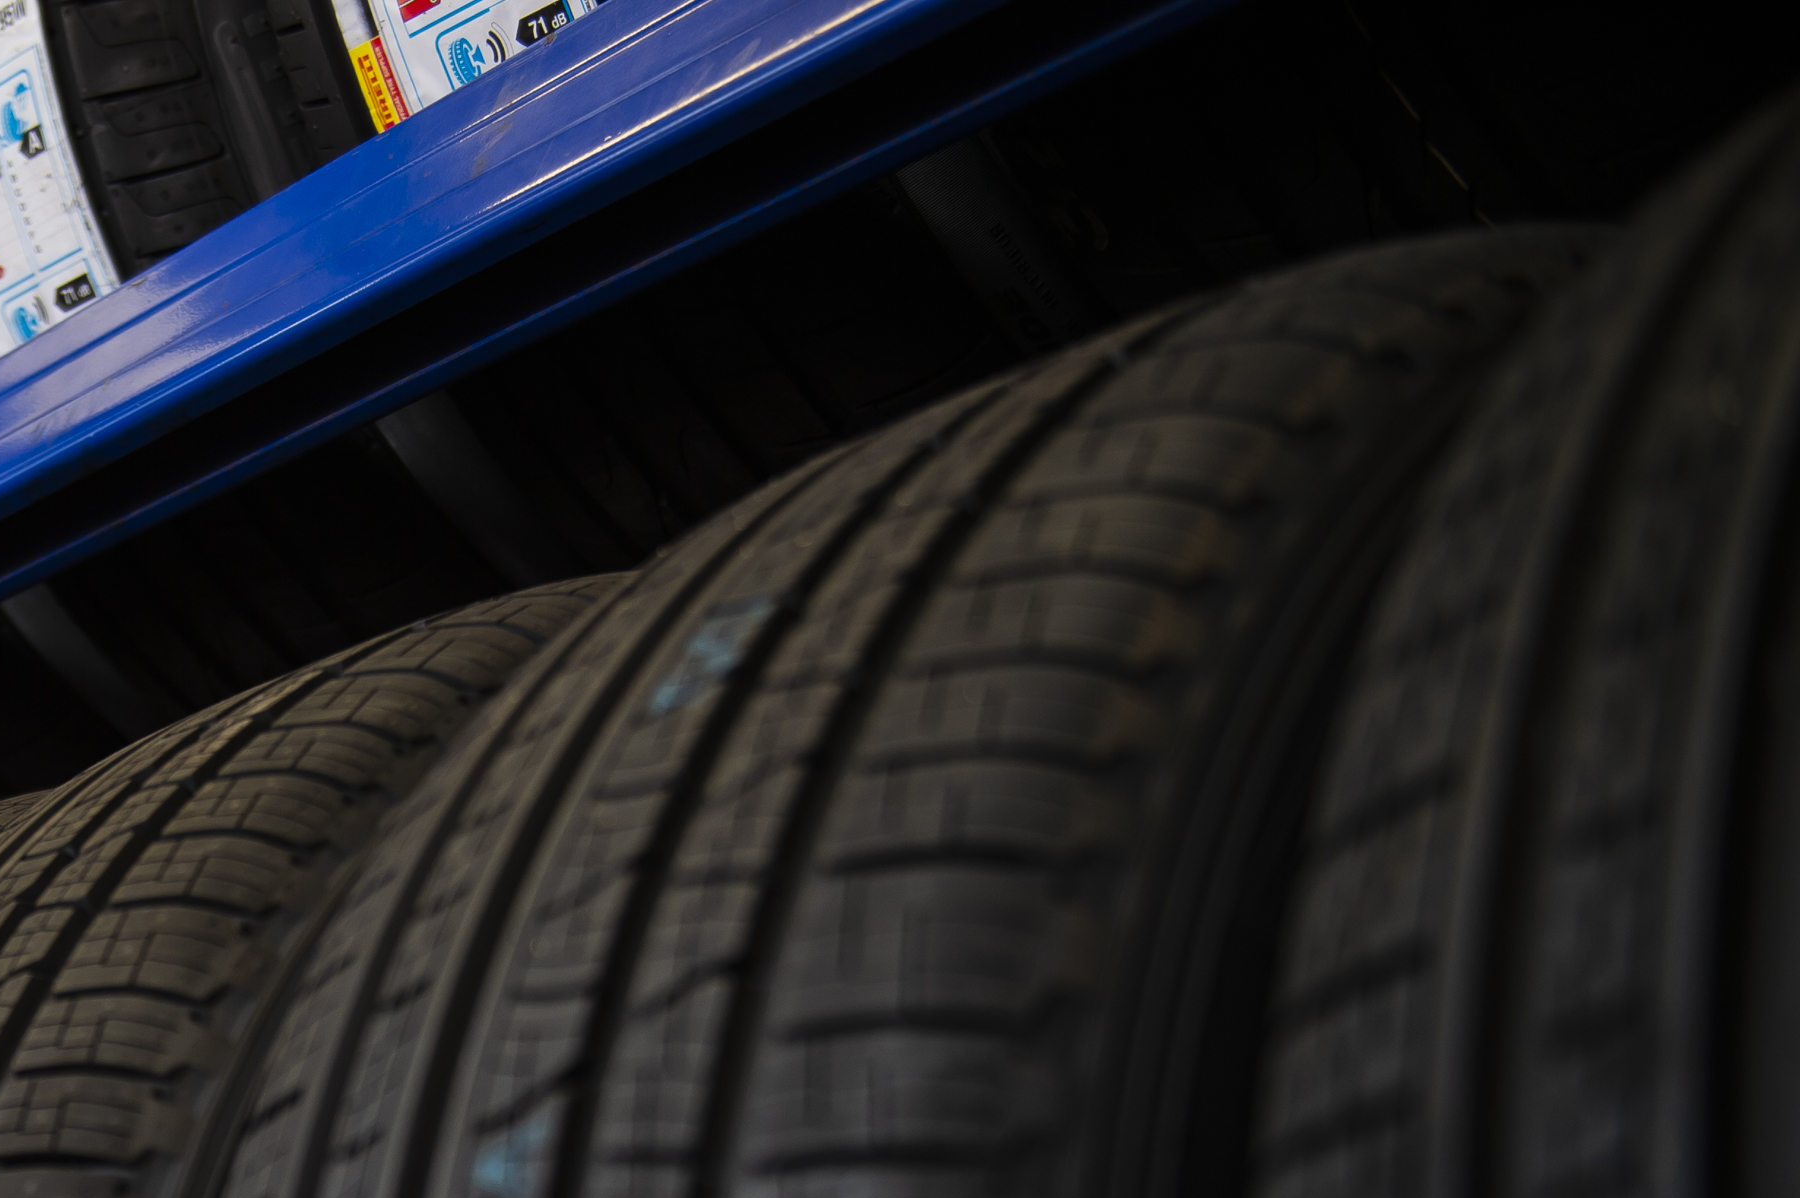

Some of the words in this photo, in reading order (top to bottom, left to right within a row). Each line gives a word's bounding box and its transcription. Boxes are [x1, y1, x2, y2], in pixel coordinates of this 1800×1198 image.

[529, 17, 548, 39] 71
[552, 13, 567, 29] dB
[29, 131, 43, 155] A
